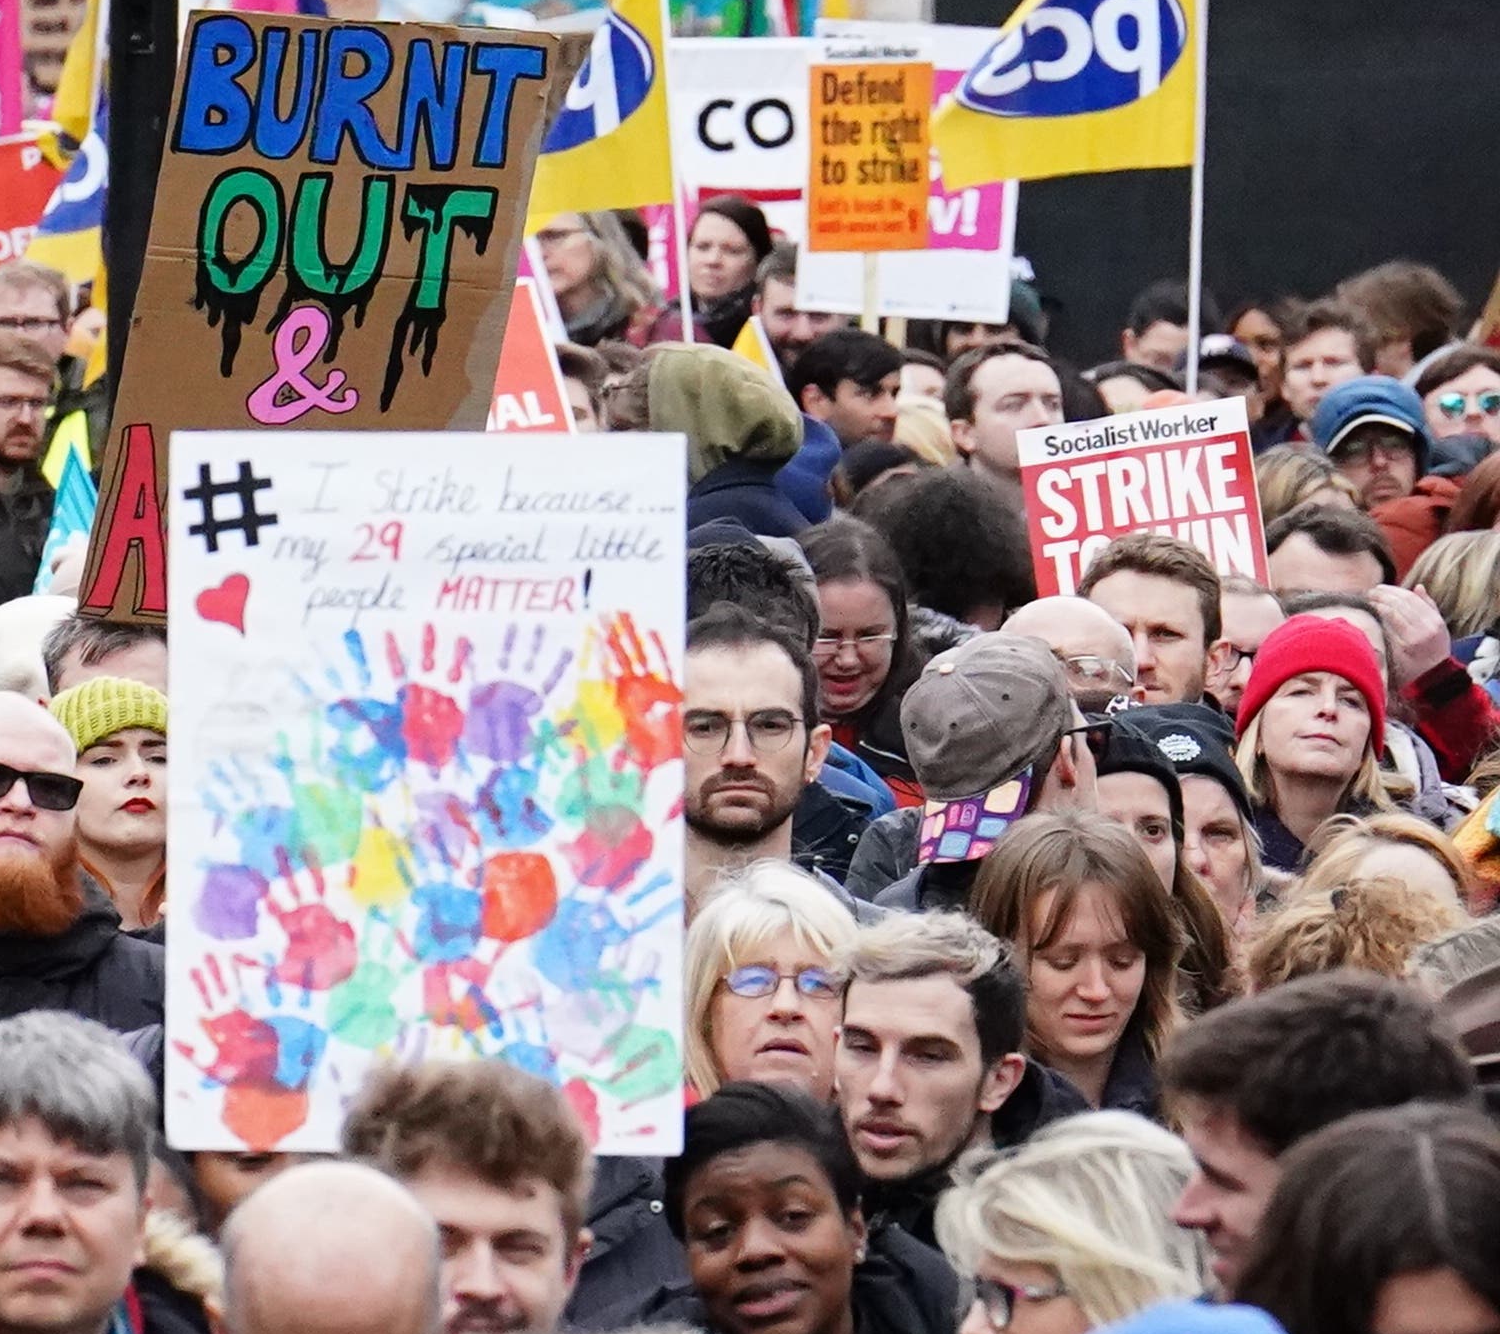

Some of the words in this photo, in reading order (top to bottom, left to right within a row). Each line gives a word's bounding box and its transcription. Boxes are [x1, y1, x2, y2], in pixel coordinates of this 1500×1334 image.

[171, 14, 548, 171] BURNT
[820, 71, 907, 105] Defend
[820, 115, 862, 145] the
[871, 111, 922, 156] right
[820, 156, 847, 184] to
[857, 155, 920, 184] strike
[196, 167, 498, 337] OUT
[245, 304, 360, 425] &
[1045, 423, 1138, 457] Socialist
[1138, 414, 1219, 440] Worker
[302, 462, 349, 515] I
[374, 466, 482, 515] Strike
[1036, 440, 1246, 539] STRIKE
[273, 533, 332, 582] my
[348, 520, 404, 563] 29
[423, 525, 549, 579] special
[569, 521, 668, 563] little
[300, 574, 407, 630] people
[435, 568, 594, 613] MATTER!
